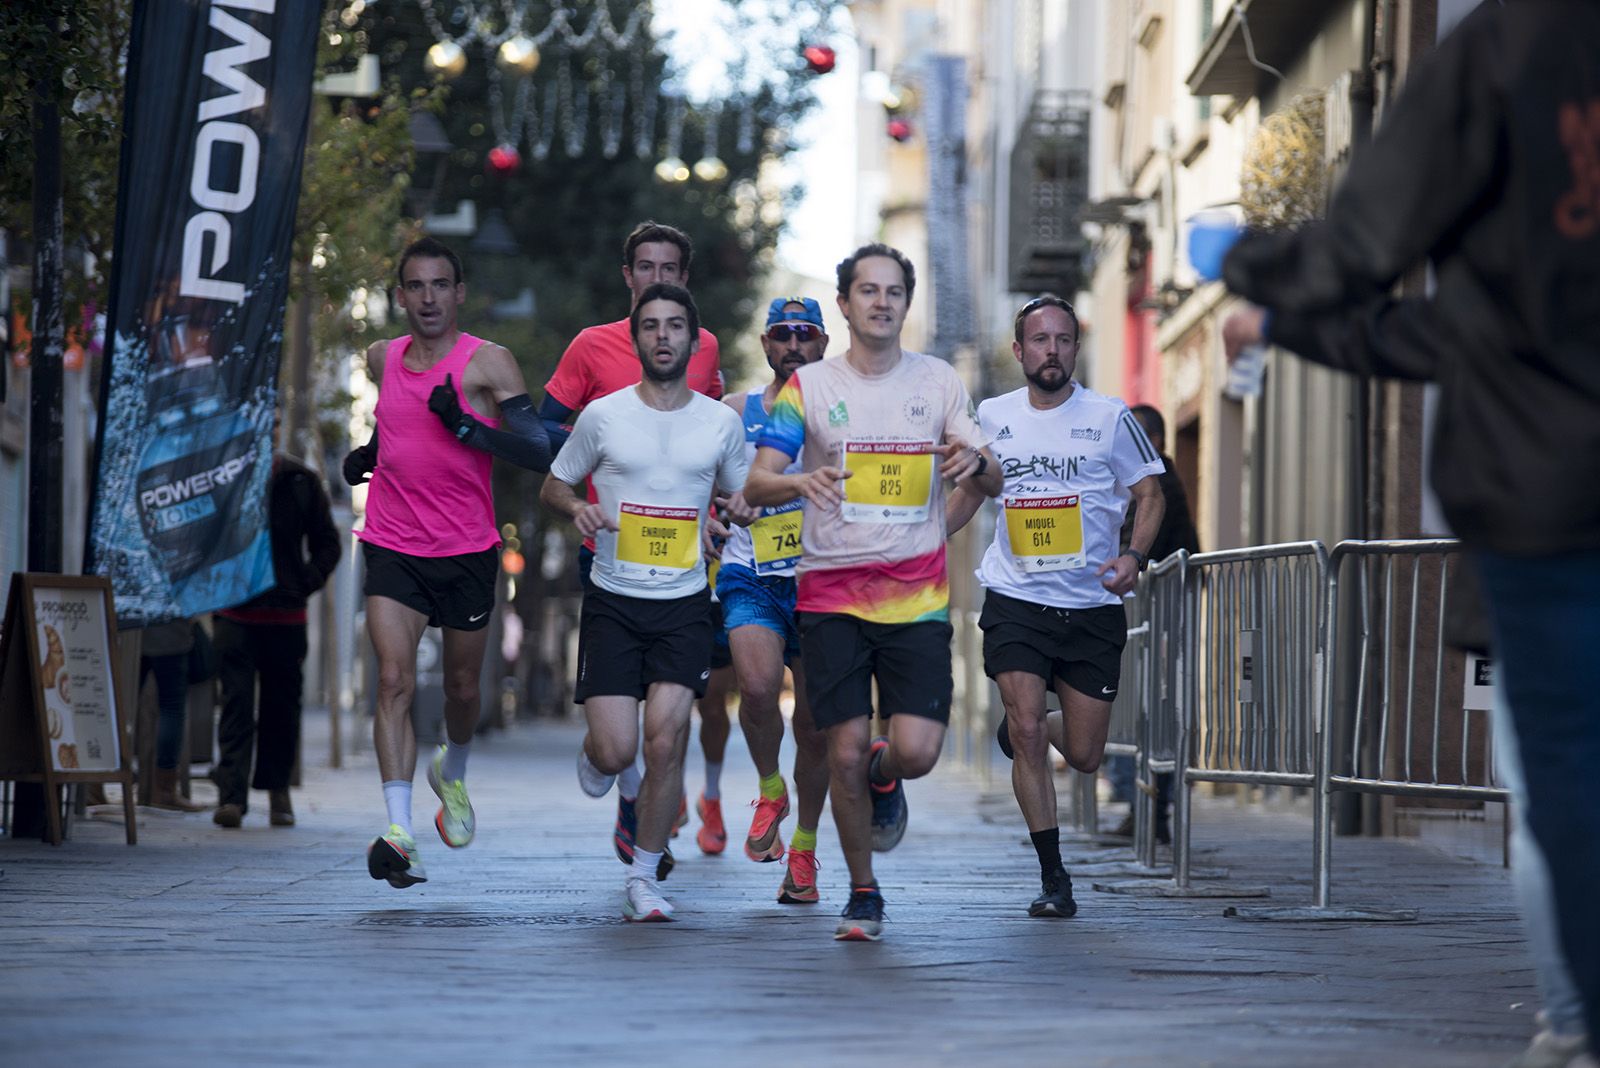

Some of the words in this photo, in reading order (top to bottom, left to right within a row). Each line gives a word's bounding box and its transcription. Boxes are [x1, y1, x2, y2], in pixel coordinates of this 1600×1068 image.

[179, 0, 276, 304] POW
[874, 444, 895, 453] SANT
[896, 445, 921, 454] CUGAT
[881, 463, 901, 476] XAVI
[880, 479, 902, 496] 825
[1024, 500, 1041, 508] SANT
[1042, 498, 1067, 507] CUGAT
[1025, 518, 1056, 529] MIQUEL
[641, 526, 678, 539] ENRIQUE
[1033, 532, 1051, 547] 614
[649, 541, 668, 556] 134
